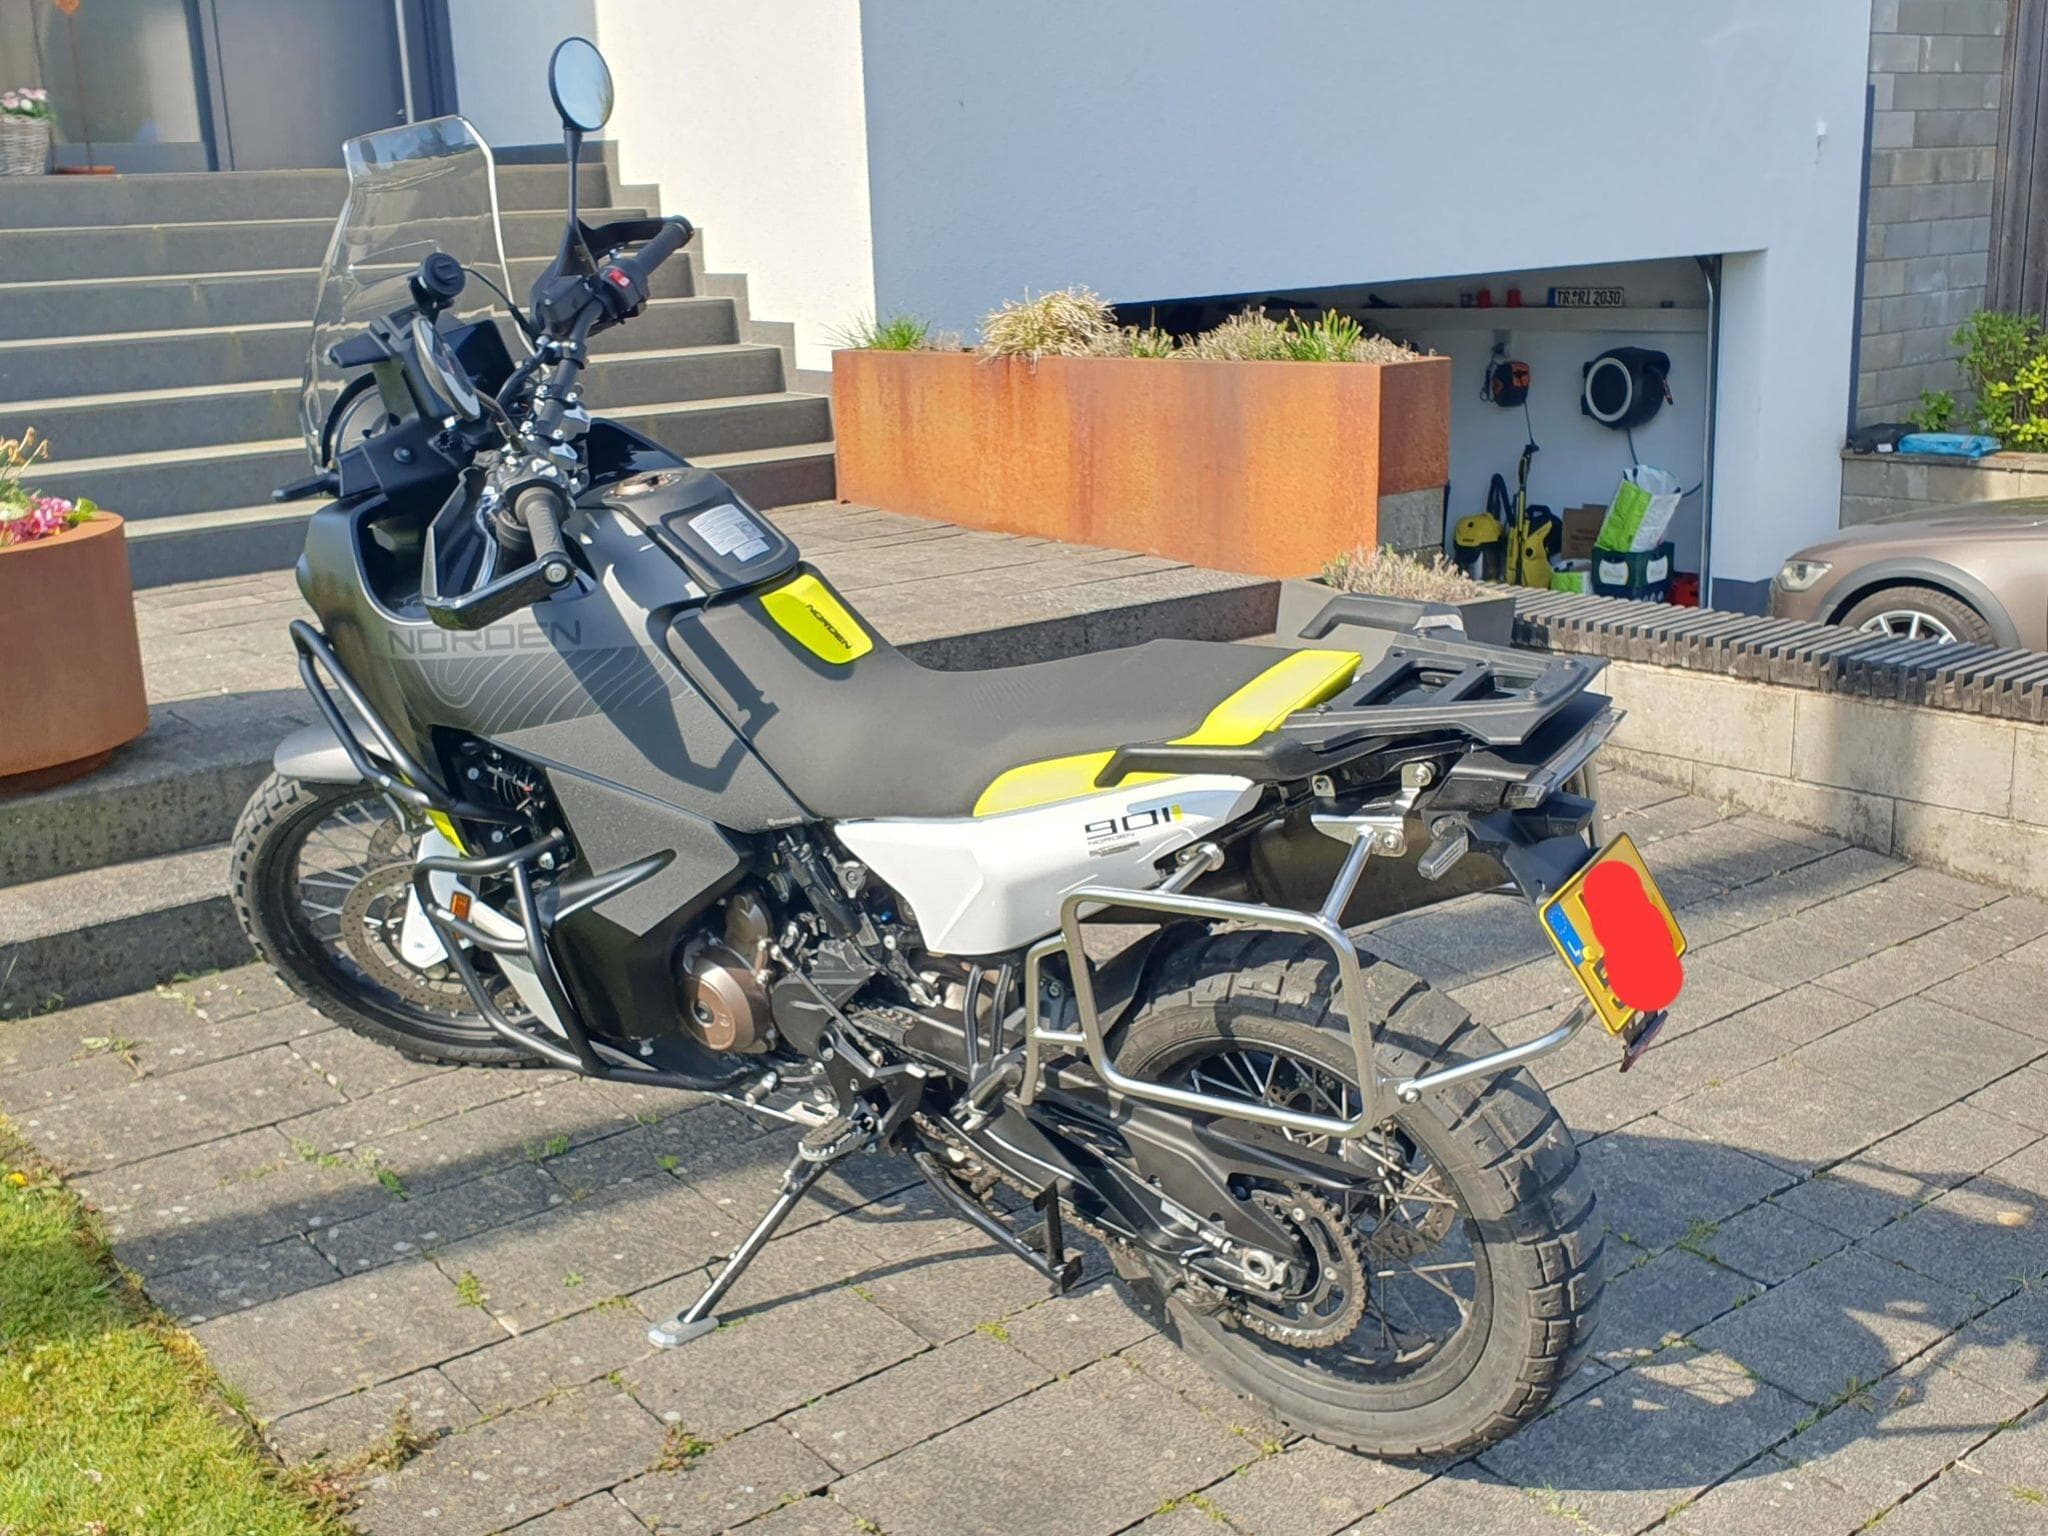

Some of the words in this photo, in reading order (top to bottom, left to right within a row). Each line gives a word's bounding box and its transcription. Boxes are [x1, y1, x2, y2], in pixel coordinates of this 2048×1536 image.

[387, 619, 582, 654] NORDEN
[806, 604, 852, 649] NORDEN
[1084, 806, 1171, 840] 901
